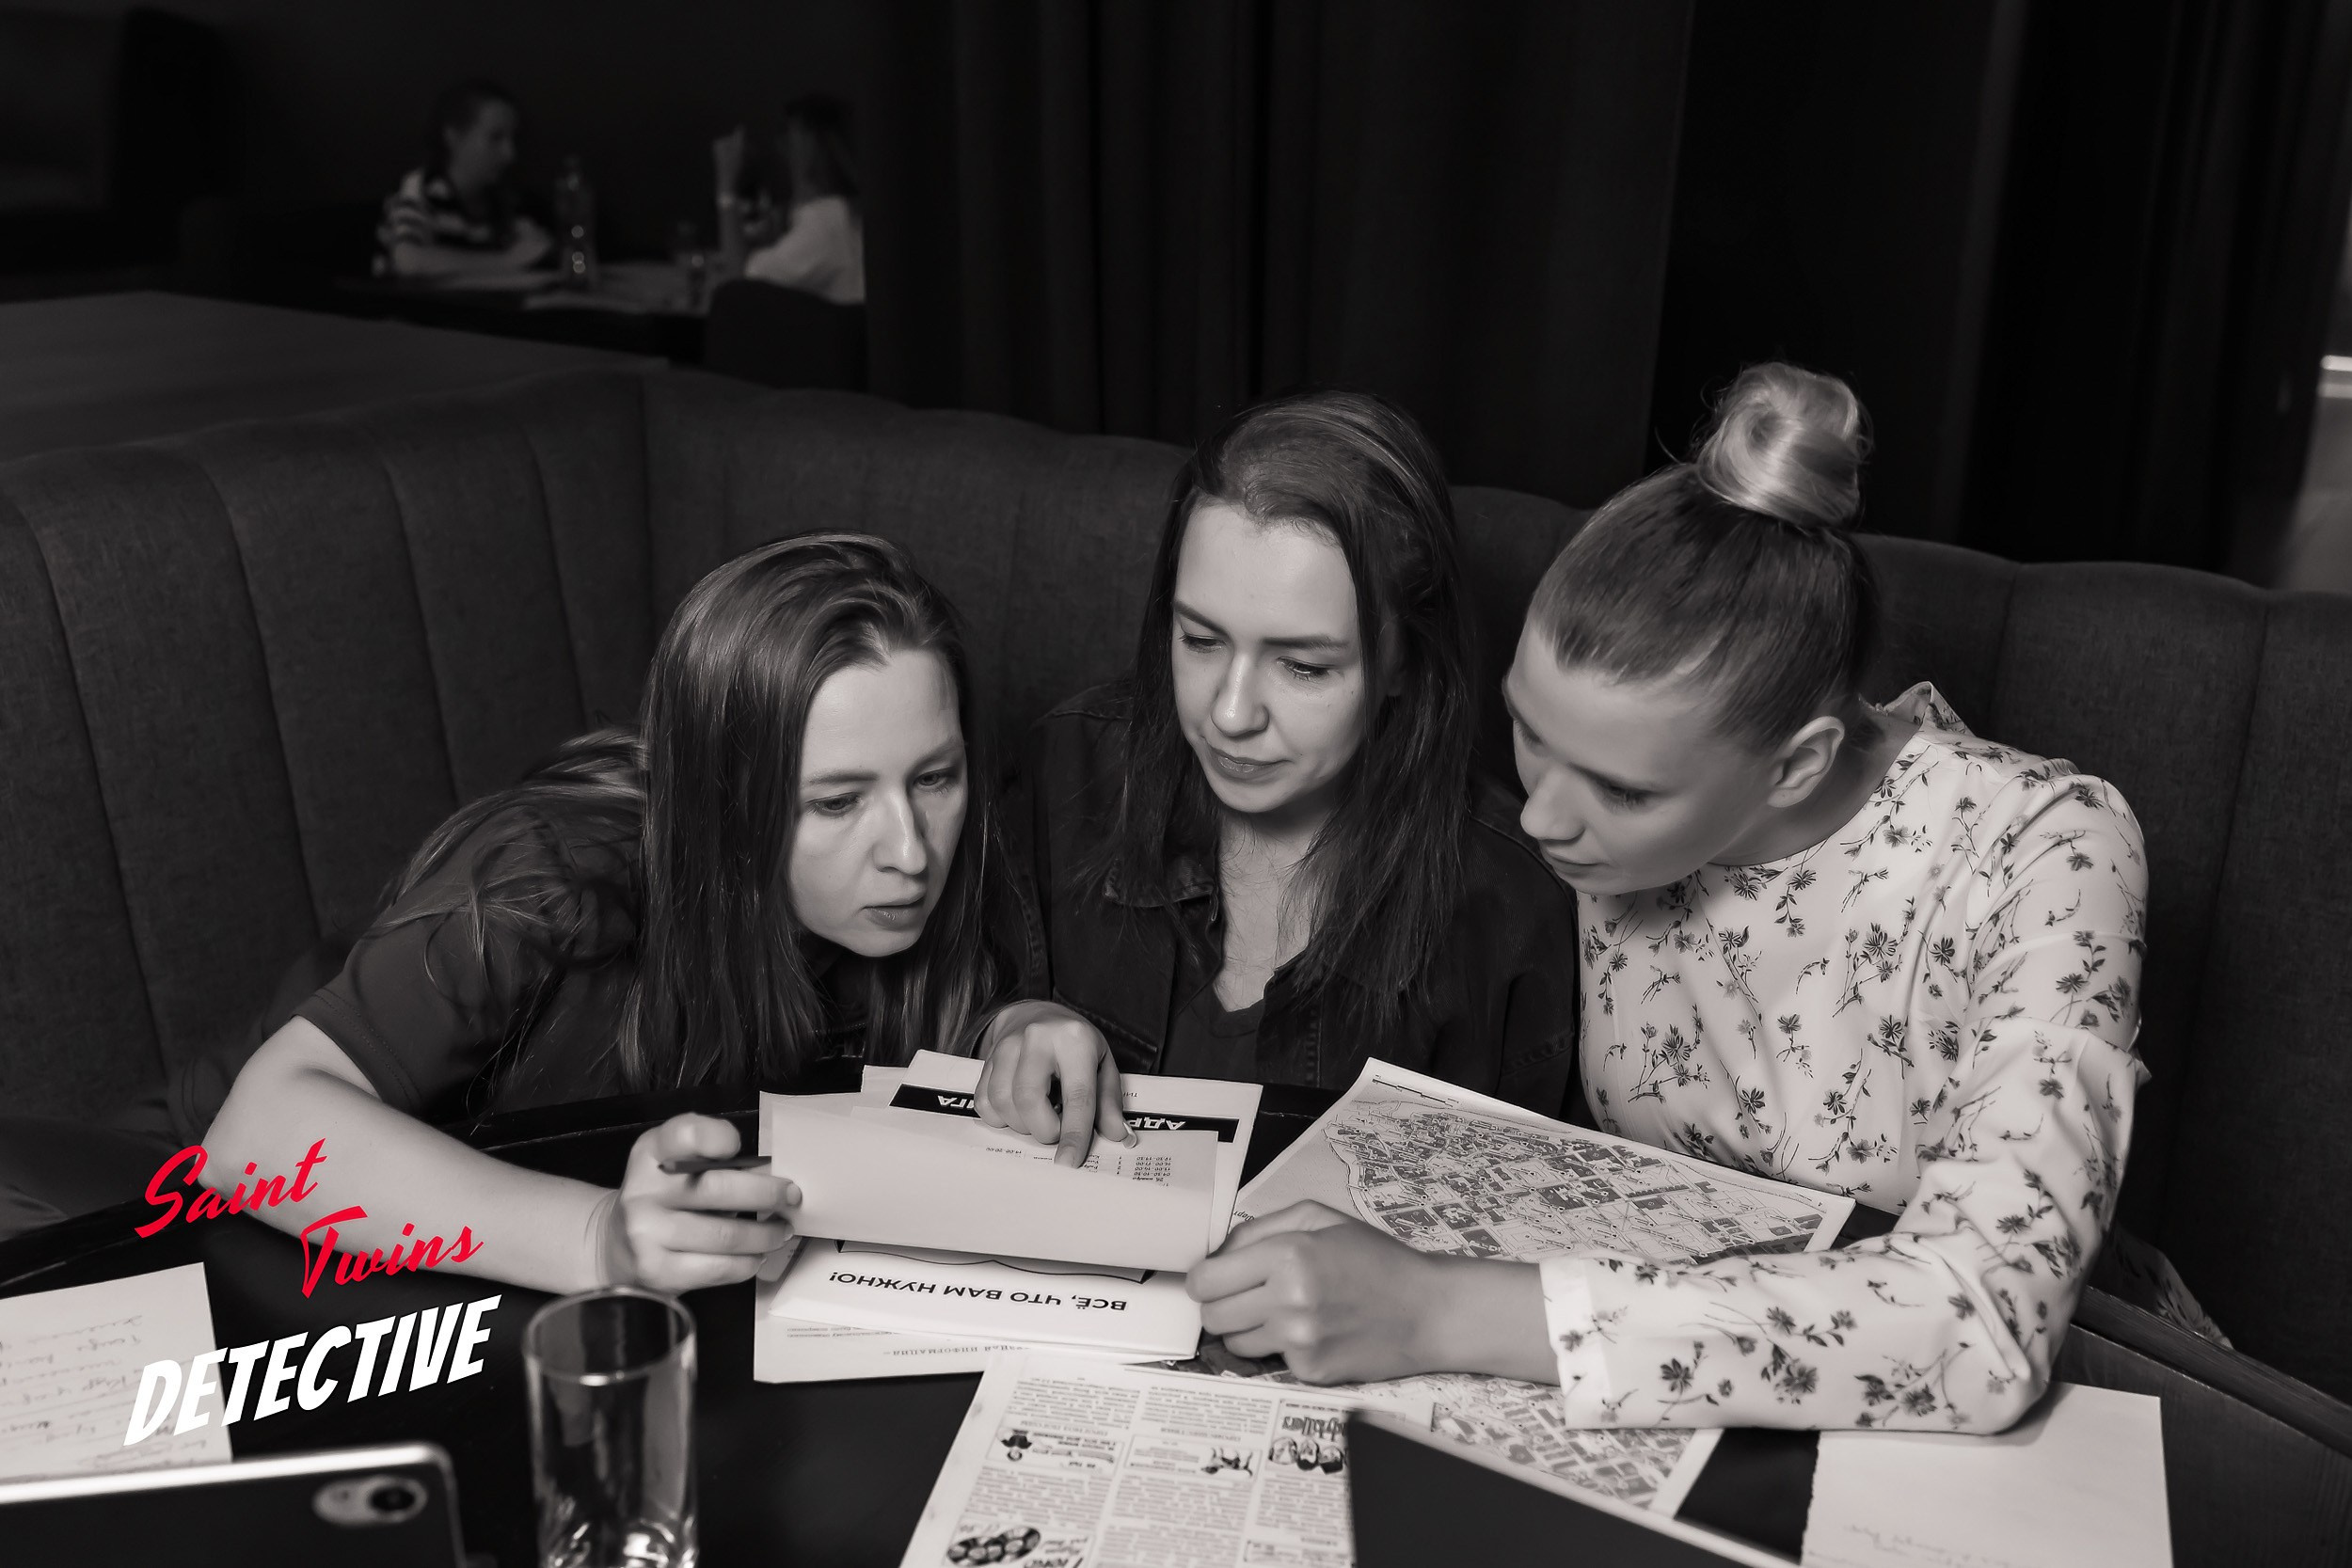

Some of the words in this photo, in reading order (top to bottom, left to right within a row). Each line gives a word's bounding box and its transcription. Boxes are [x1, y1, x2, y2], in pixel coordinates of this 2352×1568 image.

[937, 1095, 975, 1109] ГА
[1125, 1117, 1185, 1131] АДР
[829, 1272, 937, 1294] НУЖНО!
[943, 1285, 1003, 1300] ВАМ
[1009, 1292, 1061, 1306] ЧТО
[1071, 1295, 1127, 1311] ВСЁ,
